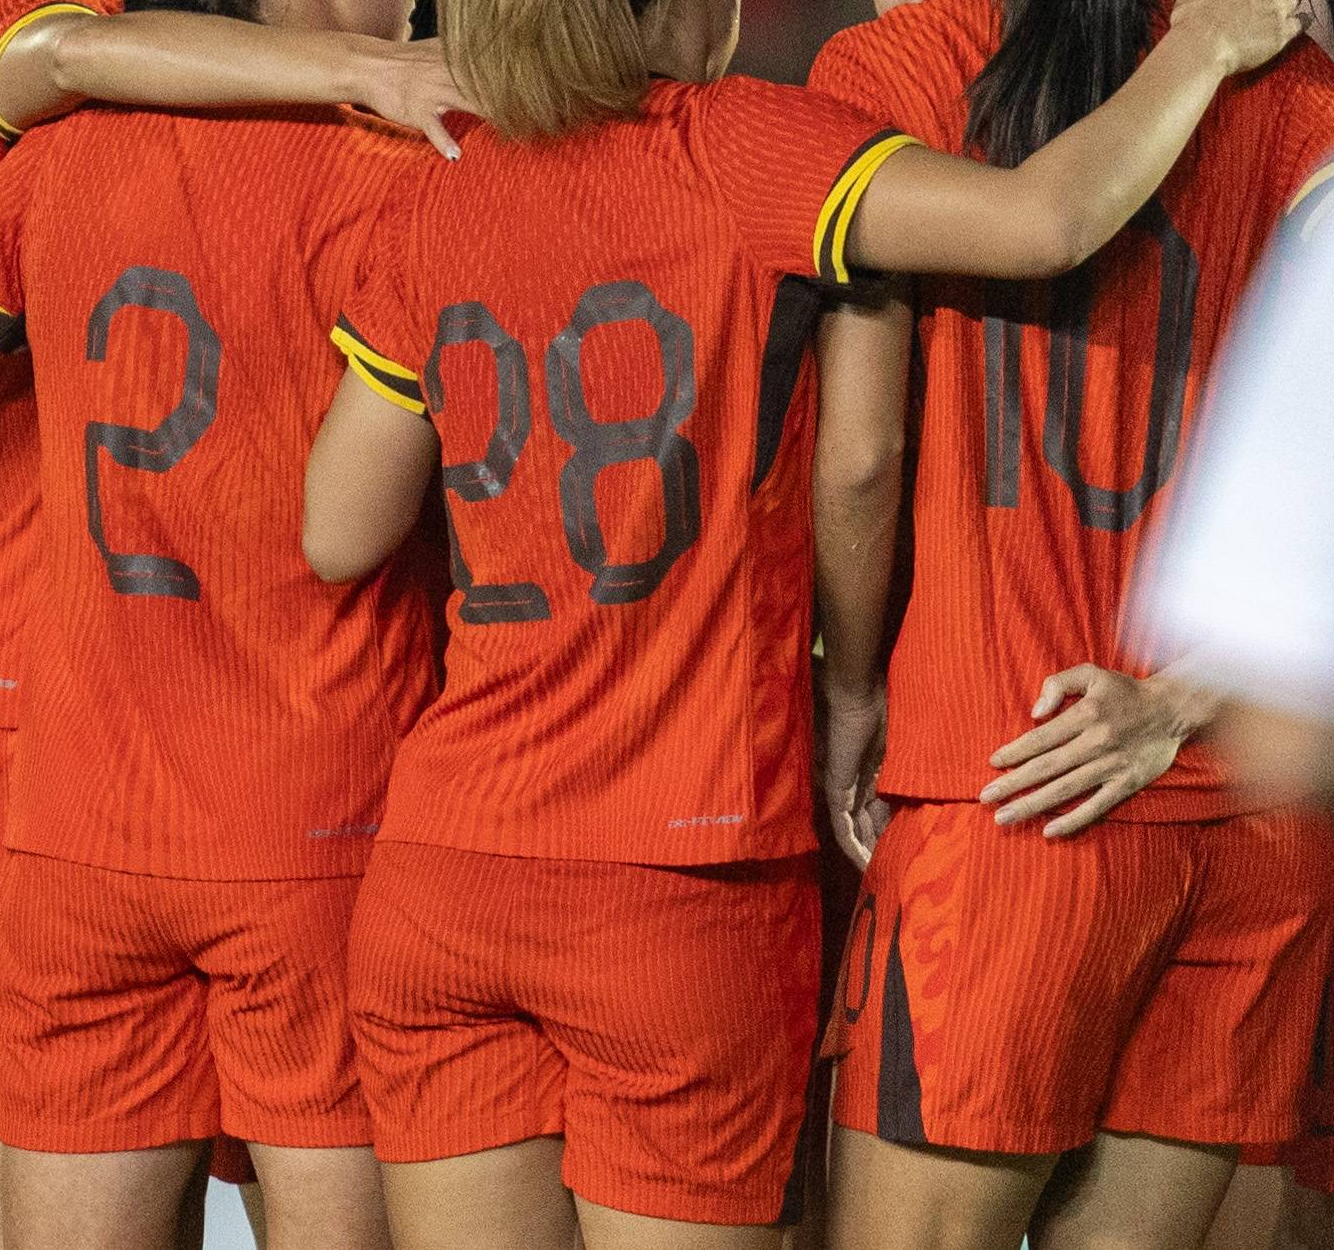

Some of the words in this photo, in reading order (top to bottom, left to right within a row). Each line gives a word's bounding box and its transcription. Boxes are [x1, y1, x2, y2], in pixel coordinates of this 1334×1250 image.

[86, 265, 220, 600] 2
[426, 280, 700, 623] 28
[983, 197, 1199, 532] 10
